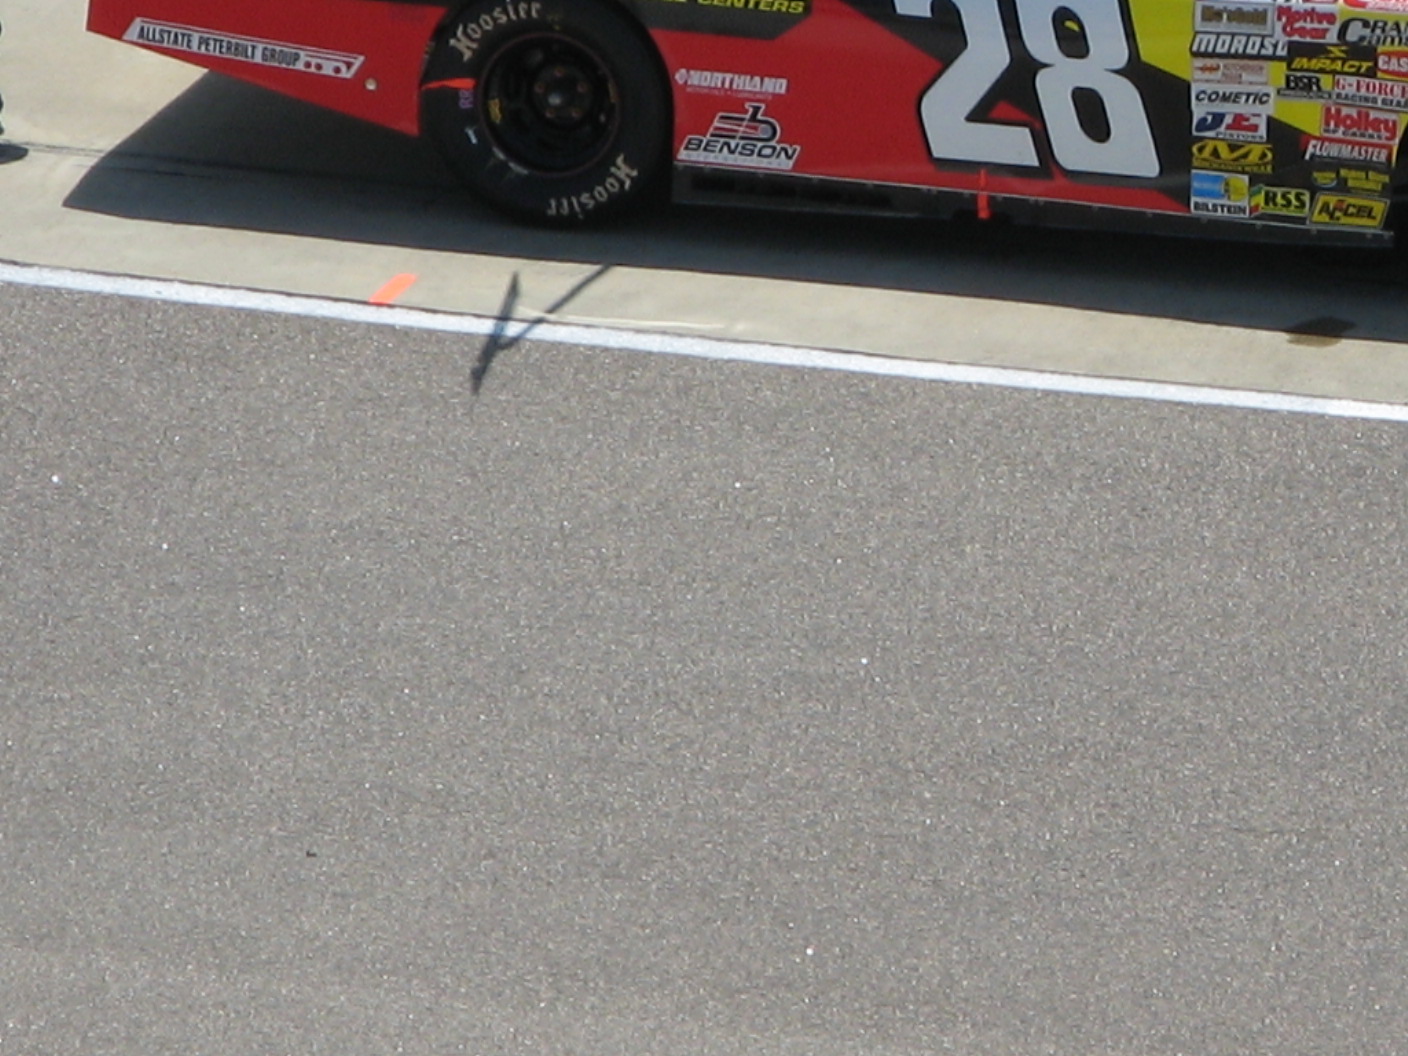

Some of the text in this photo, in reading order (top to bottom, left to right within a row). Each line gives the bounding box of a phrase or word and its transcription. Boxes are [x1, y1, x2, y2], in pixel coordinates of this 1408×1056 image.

[1276, 6, 1337, 25] Motive
[137, 25, 300, 66] ALLSTATE PETERBILT GROUP
[1191, 33, 1287, 56] MOROSO
[1292, 57, 1373, 73] IMPACT
[687, 70, 788, 94] NORTHLAND
[1286, 74, 1320, 91] BSR
[1195, 90, 1270, 105] COMETIC
[1195, 111, 1261, 133] JE
[1324, 106, 1397, 141] Holley
[683, 137, 797, 160] BENSON
[1304, 140, 1388, 162] FLOWMASTER
[547, 153, 639, 219] Hoosier
[1193, 201, 1247, 216] BILSTEIN
[1264, 191, 1307, 208] RSS
